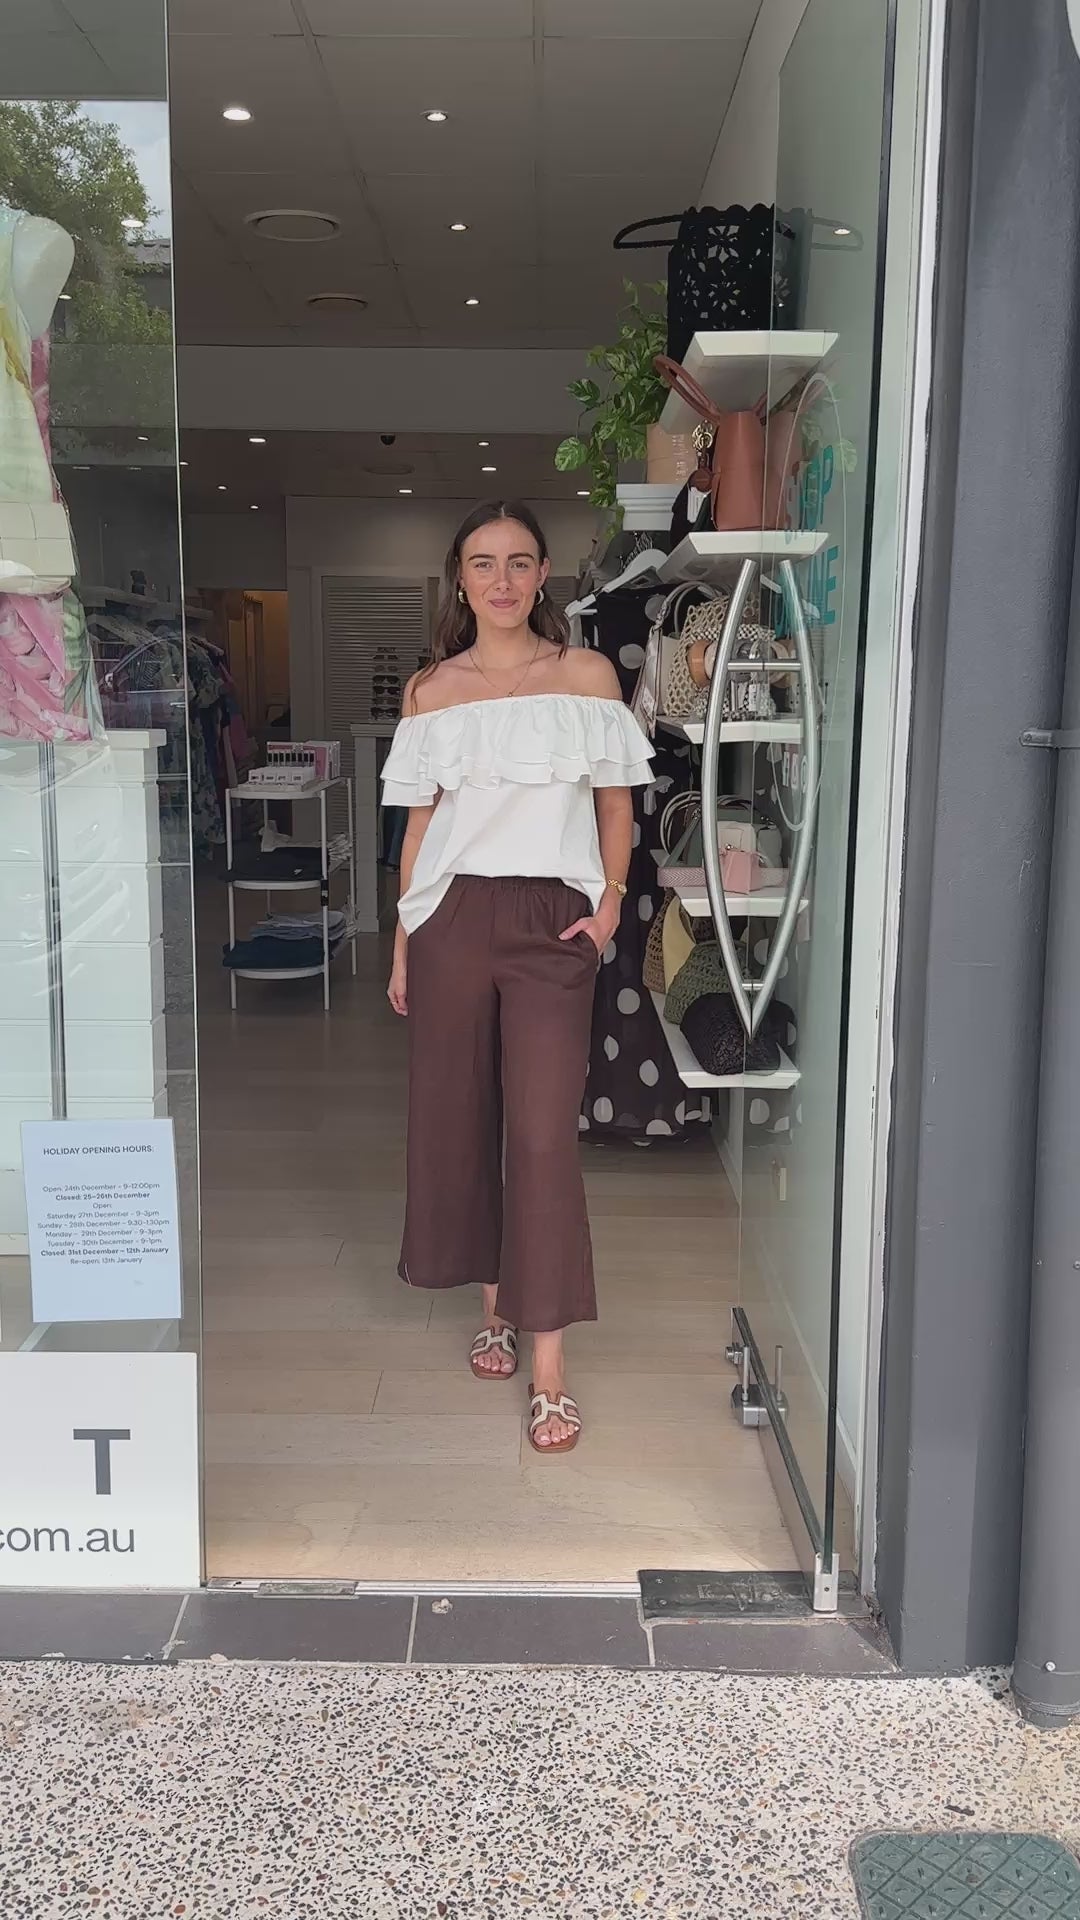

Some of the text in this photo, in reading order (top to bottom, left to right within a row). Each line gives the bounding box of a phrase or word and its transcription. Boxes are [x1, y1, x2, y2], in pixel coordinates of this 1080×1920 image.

[43, 1145, 154, 1155] HOLIDAY OPENING HOURS:
[73, 1428, 131, 1495] T
[0, 1527, 135, 1553] om.au
